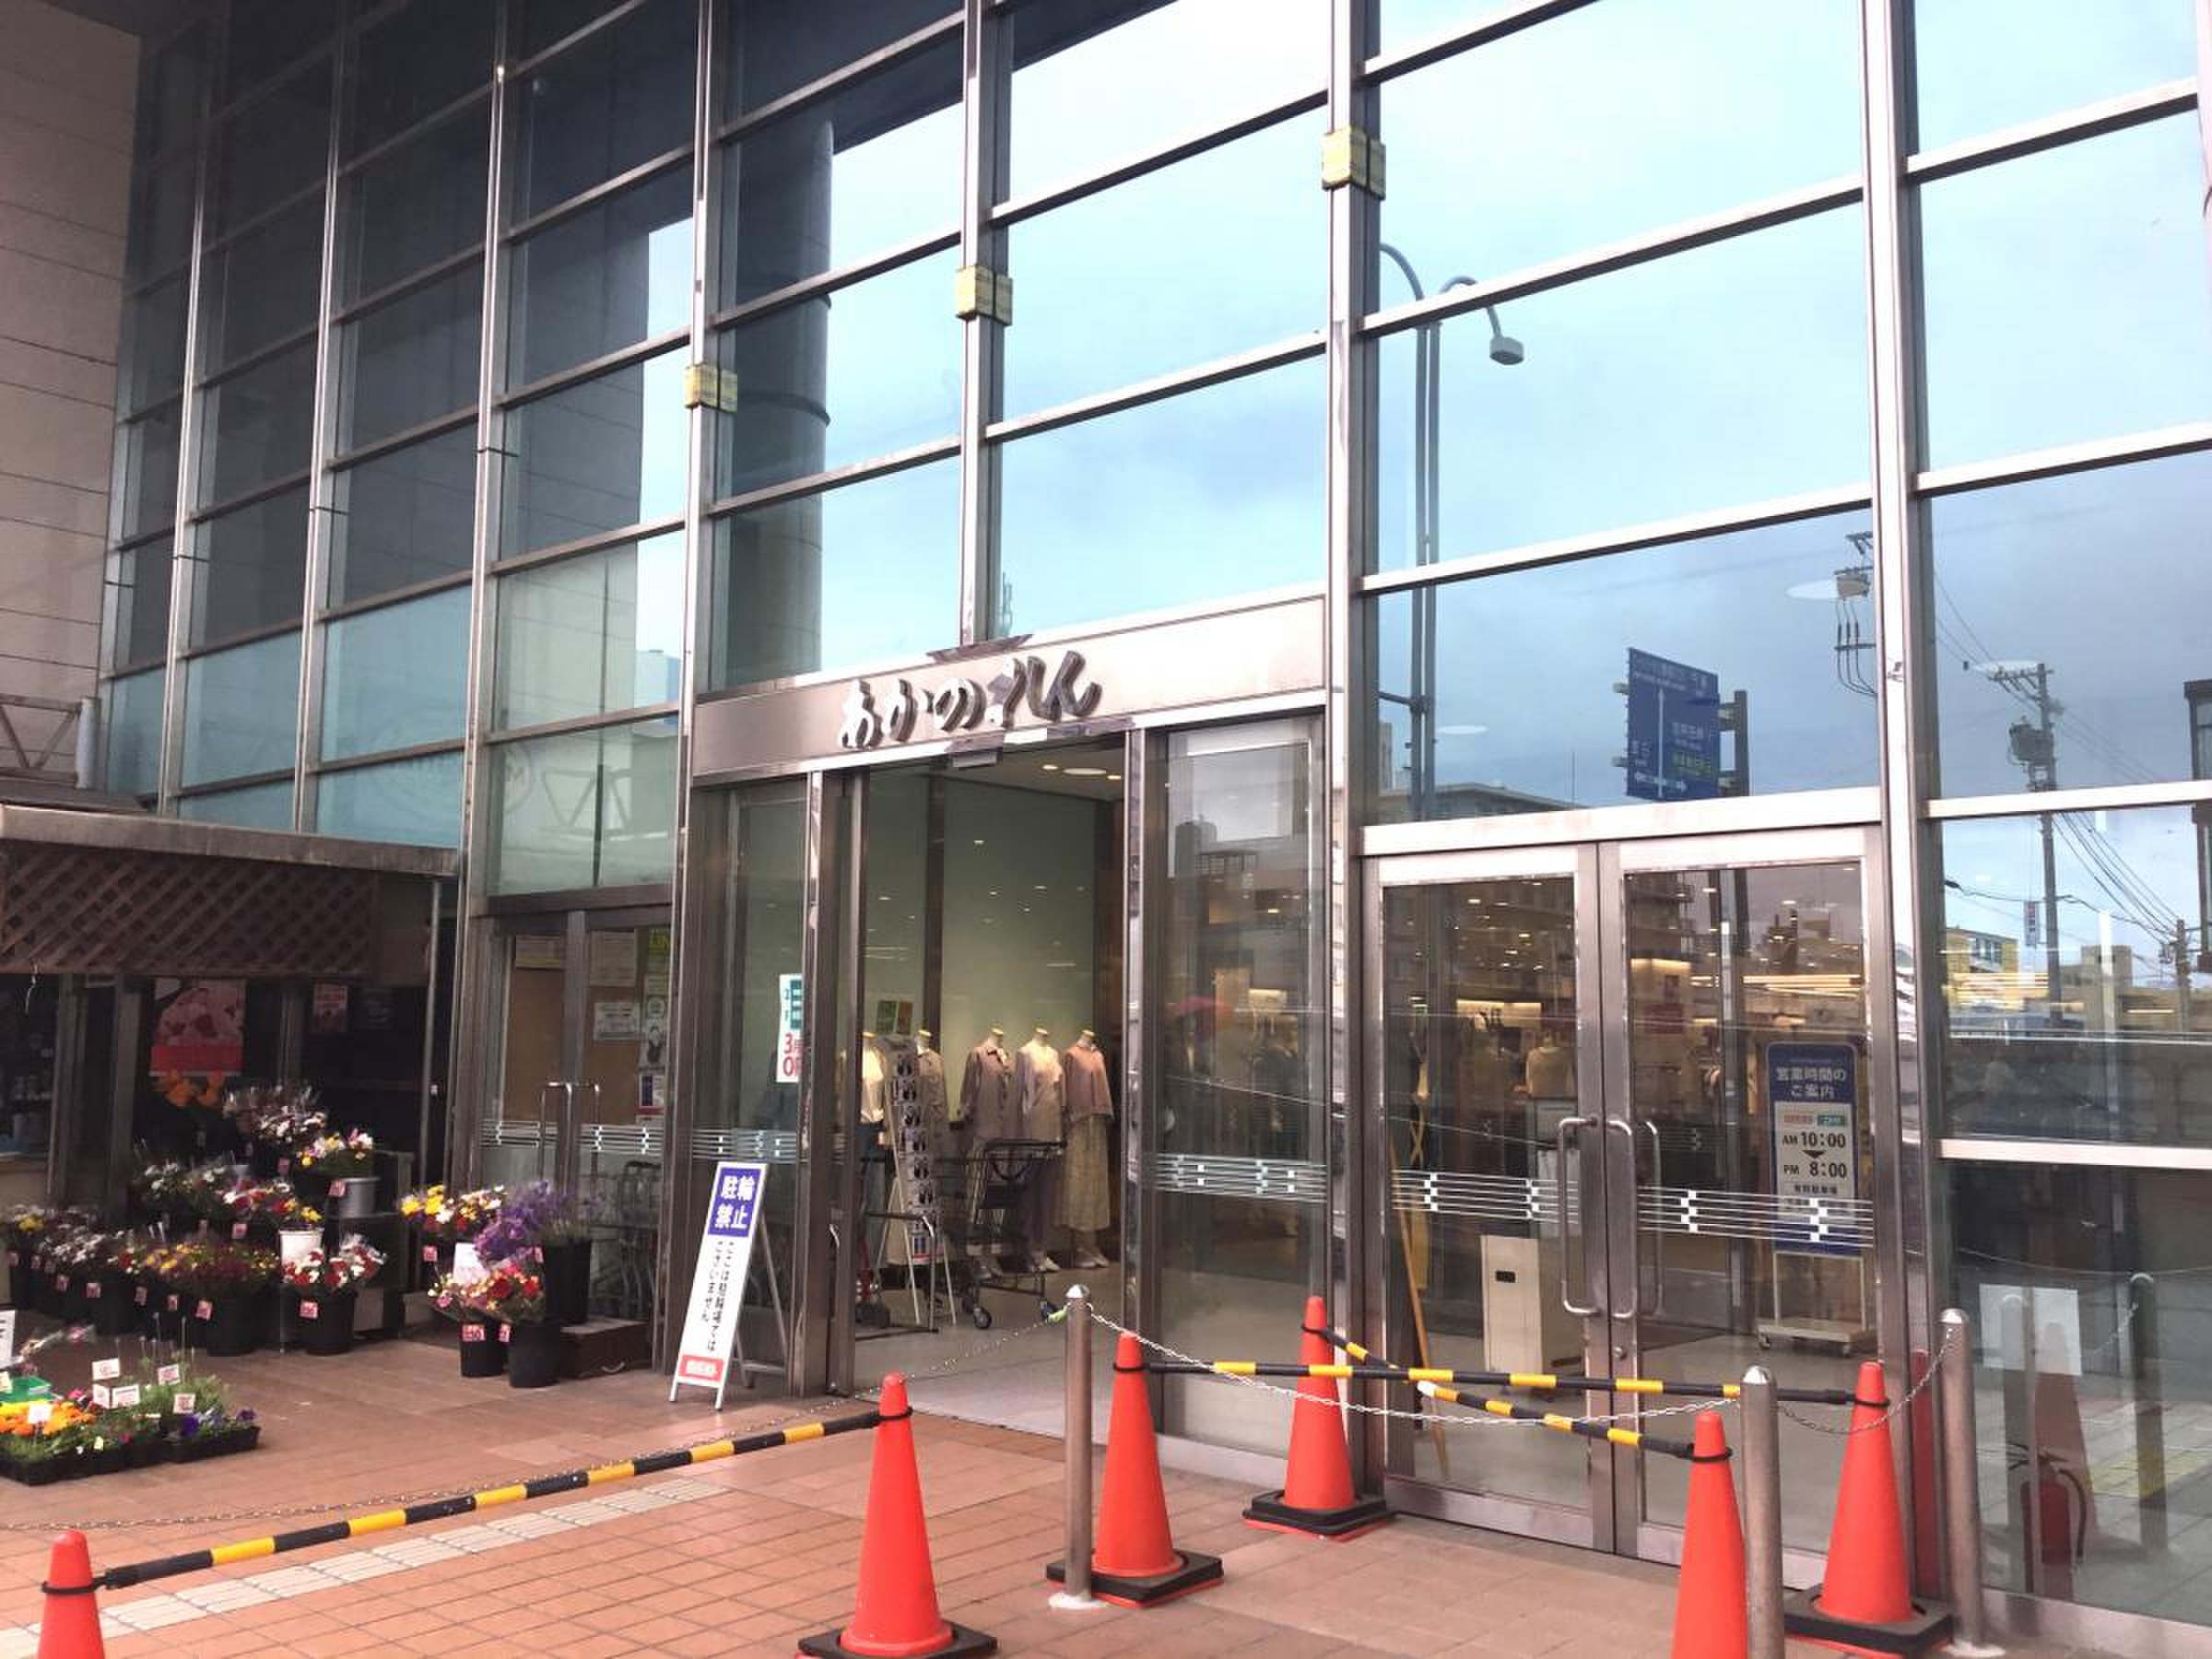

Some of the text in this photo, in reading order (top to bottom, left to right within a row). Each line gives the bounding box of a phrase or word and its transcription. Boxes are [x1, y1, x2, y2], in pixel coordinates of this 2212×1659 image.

[1776, 1066, 1847, 1083] 営業時間の
[1790, 1083, 1834, 1099] ご案内
[1783, 1132, 1846, 1148] AM 10:00
[1783, 1161, 1847, 1178] PM 8:00
[720, 1174, 756, 1201] 駐輪
[714, 1204, 748, 1230] 禁止
